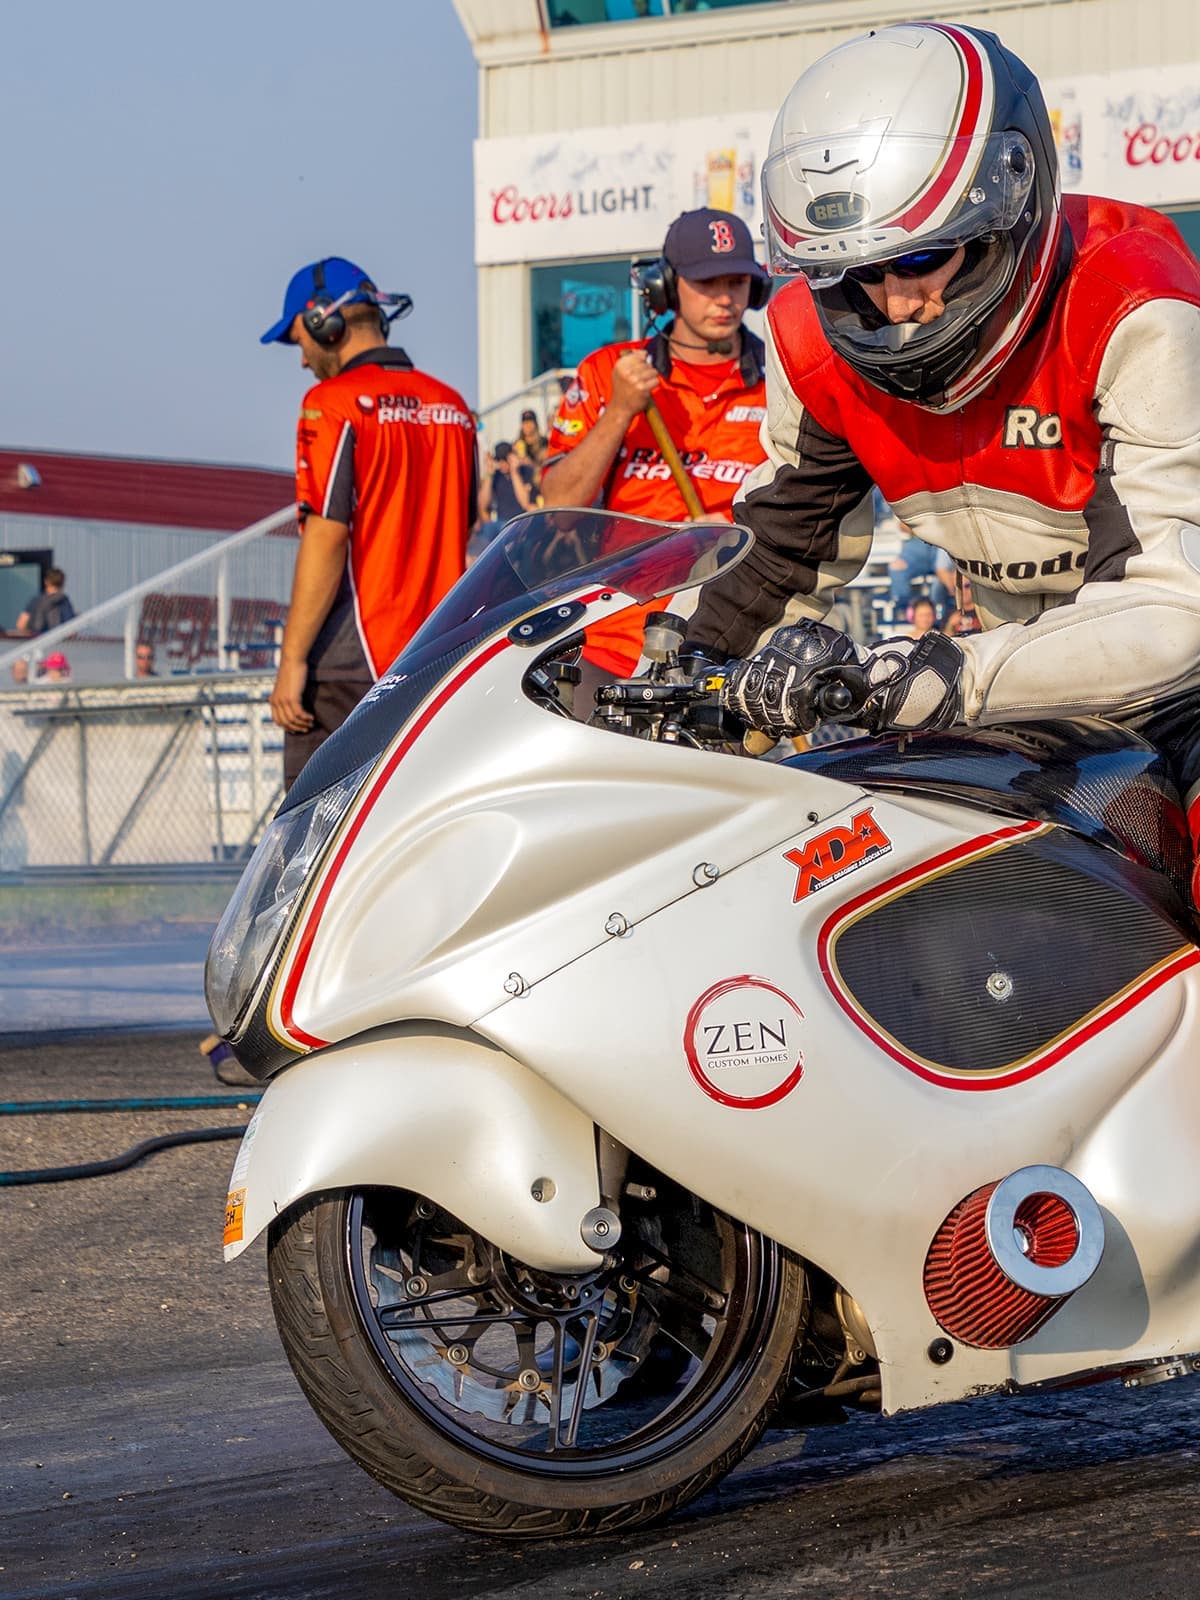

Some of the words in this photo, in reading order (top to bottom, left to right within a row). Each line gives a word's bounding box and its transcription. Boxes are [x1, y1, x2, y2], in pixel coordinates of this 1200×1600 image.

[490, 183, 574, 224] Coors
[578, 186, 655, 216] LIGHT
[814, 202, 861, 221] BELL
[708, 220, 736, 253] B
[377, 394, 421, 409] RAD
[631, 447, 708, 467] RD
[623, 461, 749, 484] RAEW
[782, 806, 890, 903] XDA
[703, 1018, 787, 1056] ZEN
[707, 1057, 750, 1070] CUSTOM
[754, 1053, 789, 1065] HOMES
